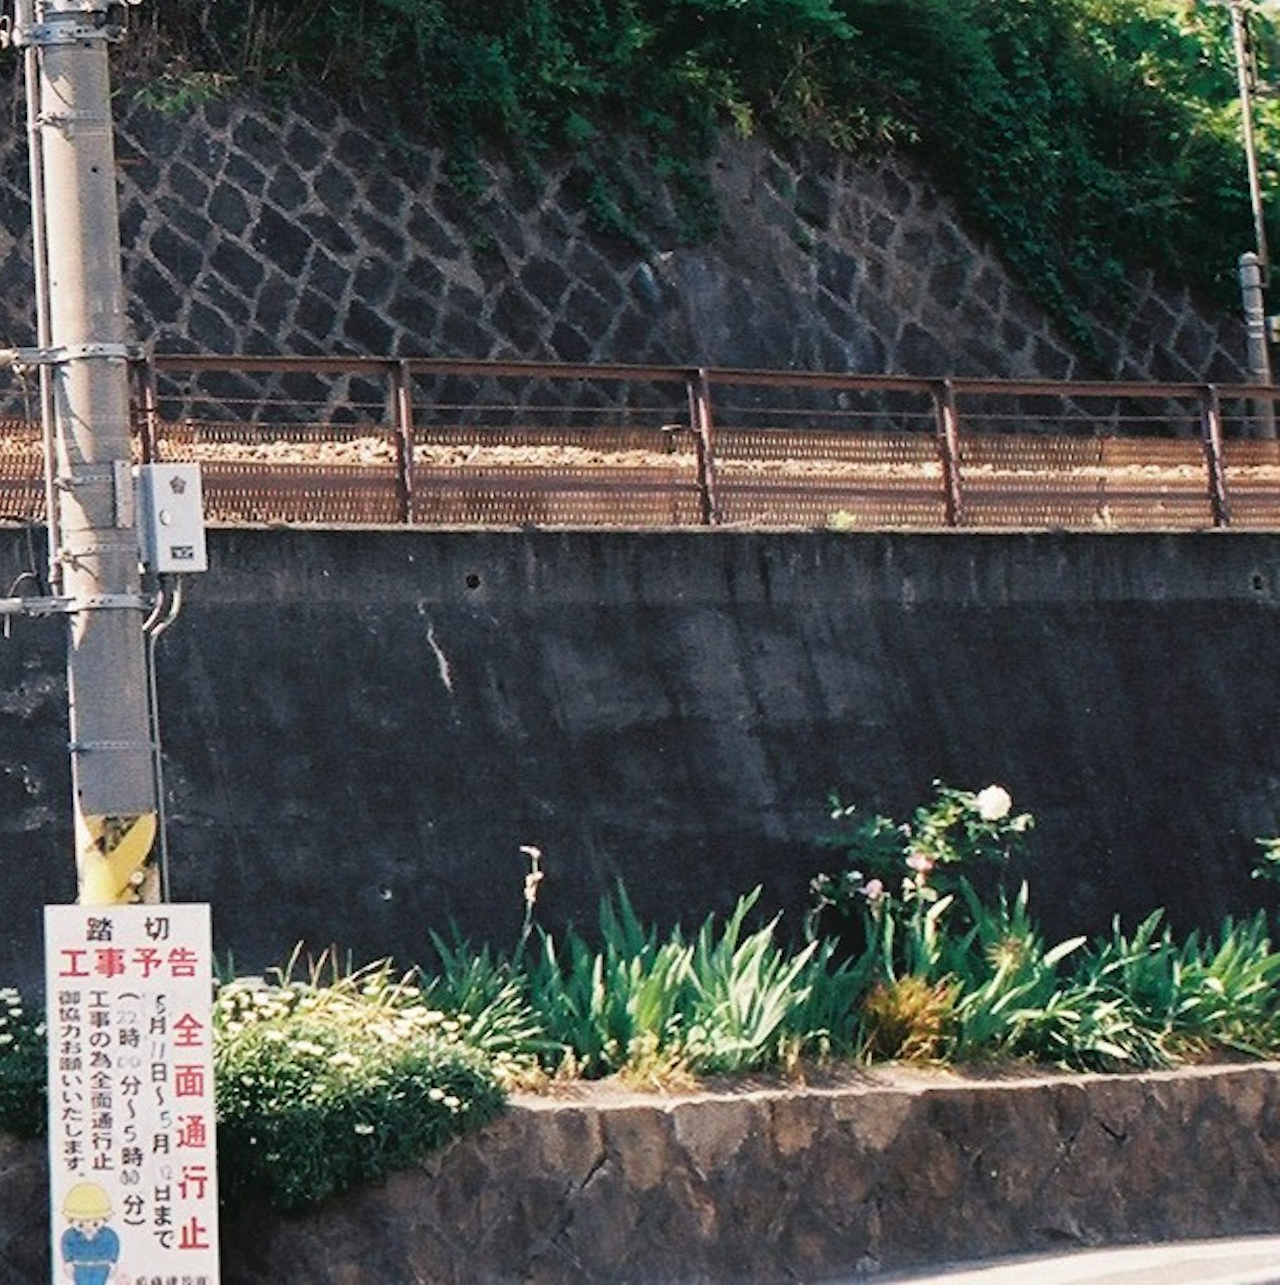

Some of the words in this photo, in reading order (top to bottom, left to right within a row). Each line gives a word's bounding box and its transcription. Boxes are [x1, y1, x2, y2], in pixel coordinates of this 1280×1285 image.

[59, 947, 198, 979] 工事予告
[86, 917, 170, 941] 踏切
[88, 990, 114, 1171] 工事の為全面通行止
[172, 1013, 210, 1250] 全面通行止
